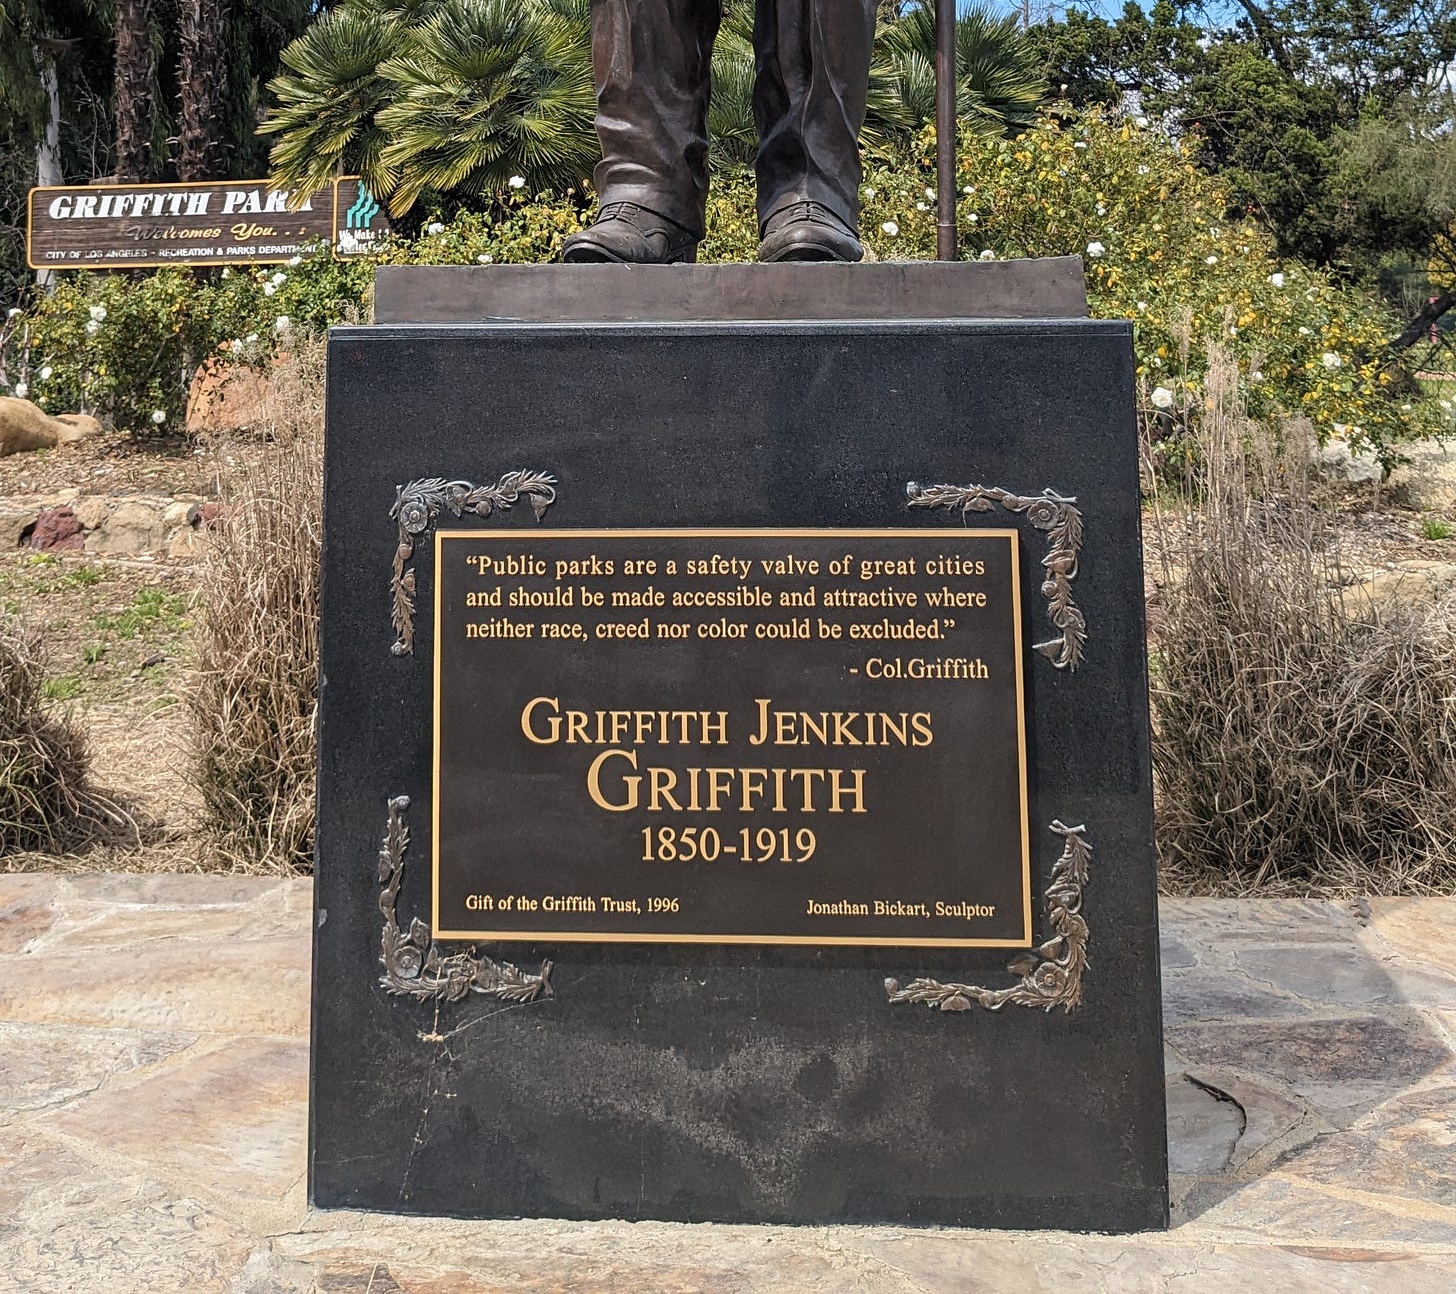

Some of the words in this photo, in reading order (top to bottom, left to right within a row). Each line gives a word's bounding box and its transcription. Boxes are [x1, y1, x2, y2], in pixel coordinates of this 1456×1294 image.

[49, 192, 212, 220] GRIFFITH
[126, 225, 222, 241] Welcomes
[46, 251, 66, 260] CITY
[69, 251, 82, 259] OF
[84, 250, 103, 259] LOS
[105, 249, 148, 258] ANGELES
[159, 247, 214, 257] RECREATION
[216, 247, 223, 256] &
[226, 246, 256, 255] PARKS
[555, 554, 615, 581] parks
[623, 560, 657, 575] are
[666, 560, 678, 575] a
[686, 554, 753, 580] safety
[760, 554, 820, 575] valve
[828, 554, 854, 575] of
[860, 557, 917, 580] great
[925, 554, 985, 575] cities
[466, 586, 502, 607] and
[508, 585, 574, 607] should
[580, 585, 605, 607] be
[611, 585, 665, 607] made
[672, 585, 773, 607] accessible
[779, 585, 816, 607] and
[823, 586, 918, 607] attractive
[924, 586, 987, 607] where
[465, 617, 535, 638] neither
[540, 623, 588, 642] race,
[595, 617, 650, 639] creed
[656, 623, 691, 639] nor
[697, 617, 749, 639] color
[754, 617, 811, 639] could
[817, 617, 842, 639] be
[641, 826, 817, 863] 1850-1919
[465, 894, 494, 911] Gift
[497, 895, 515, 911] of
[516, 895, 538, 911] the
[542, 895, 597, 912] Griffith
[600, 896, 642, 915] Trust,
[647, 897, 680, 913] 1996
[806, 899, 869, 915] Jonathan
[873, 900, 931, 919] Bickart,
[935, 901, 996, 921] Sculptor
